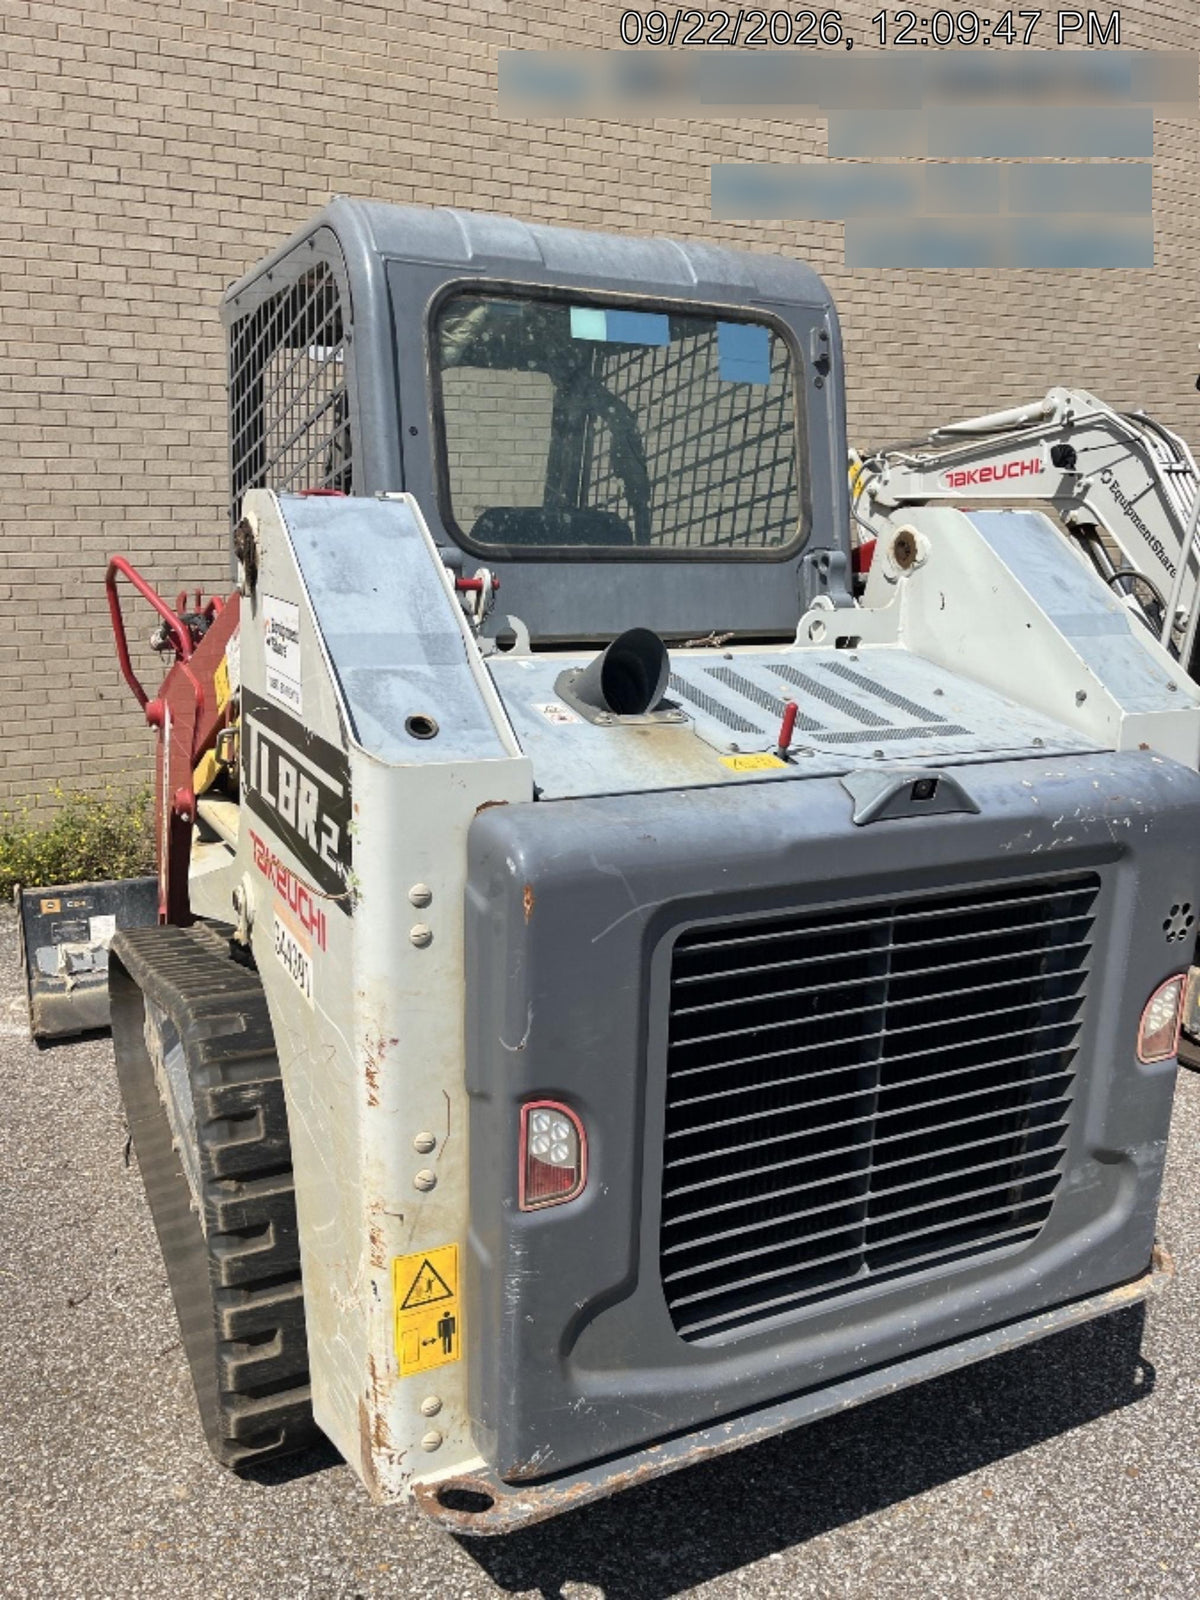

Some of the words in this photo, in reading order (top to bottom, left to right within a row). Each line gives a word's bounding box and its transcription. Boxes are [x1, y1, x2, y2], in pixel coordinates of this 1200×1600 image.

[945, 458, 1040, 488] TAKEUCHI
[1109, 480, 1177, 579] EquipmentShare
[248, 828, 327, 952] TAKEUCHI
